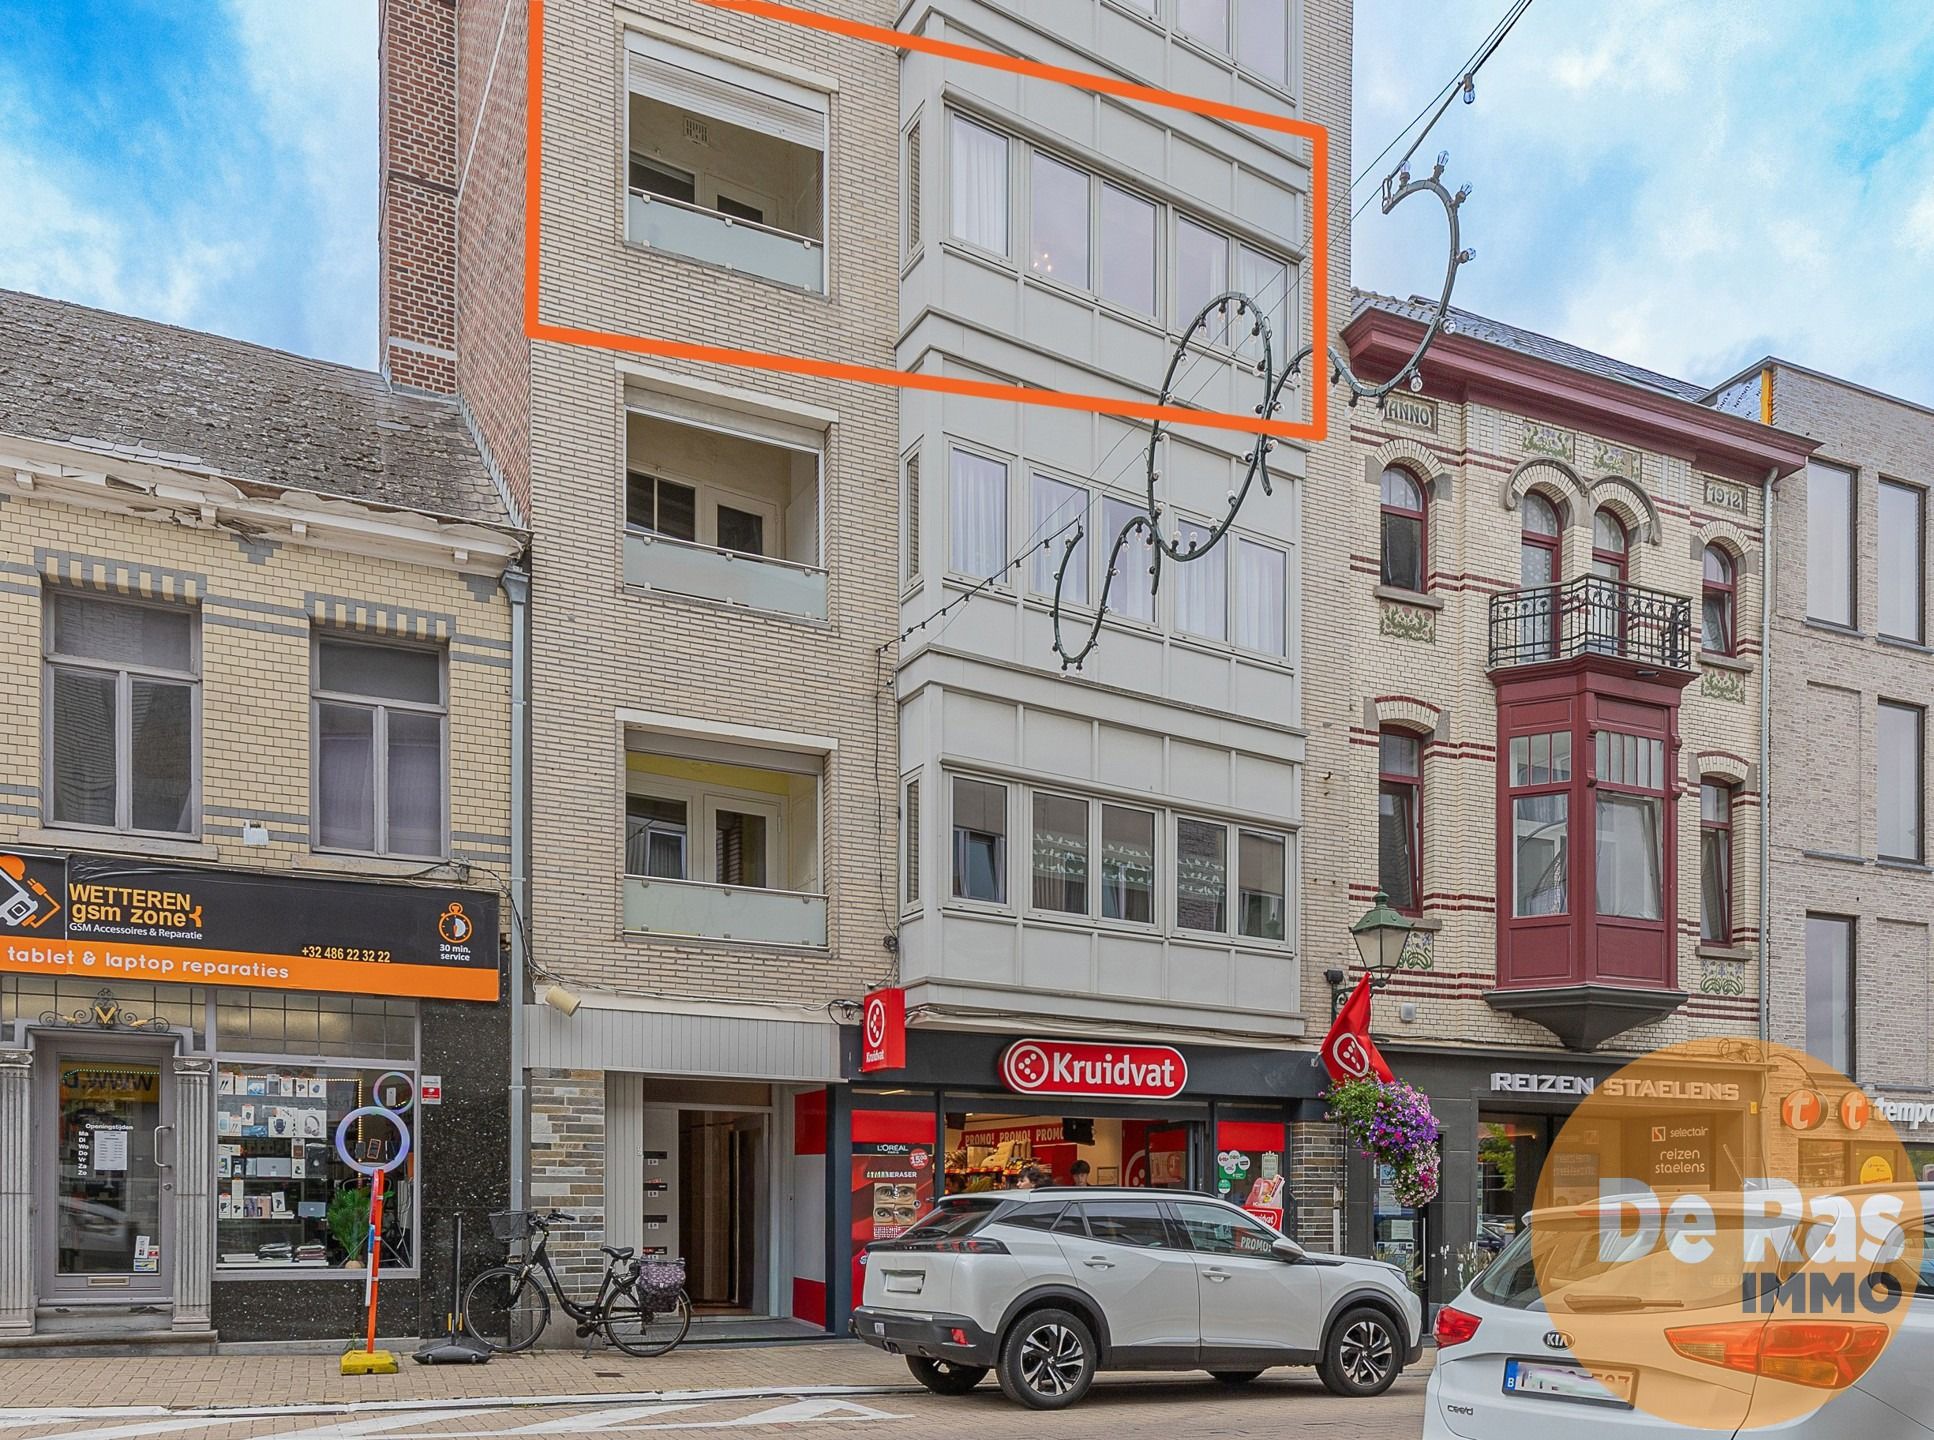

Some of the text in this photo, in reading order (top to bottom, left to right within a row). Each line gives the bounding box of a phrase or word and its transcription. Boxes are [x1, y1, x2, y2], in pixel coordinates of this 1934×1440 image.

[1390, 401, 1429, 425] ANNO
[1709, 487, 1740, 508] 1912
[69, 883, 190, 911] WETTEREN
[72, 904, 186, 927] gsm zone
[69, 923, 203, 940] GSM Accessoires & Reparatie
[302, 946, 390, 963] +32 486 22 32 22
[439, 944, 471, 953] 30 min.
[440, 952, 471, 961] service
[8, 946, 289, 979] tablet & laptop reparaties
[1053, 1052, 1175, 1087] Kruidvat
[1490, 1072, 1739, 1100] REIZEN STAELENS
[85, 1123, 134, 1131] Openingstijden
[1670, 1126, 1709, 1138] selectair
[965, 1132, 995, 1146] PROMO!
[1000, 1129, 1031, 1142] PROMO!
[1660, 1148, 1700, 1160] reizen
[1655, 1161, 1705, 1174] staelens
[1547, 1333, 1569, 1347] KIA
[1507, 1378, 1514, 1387] B
